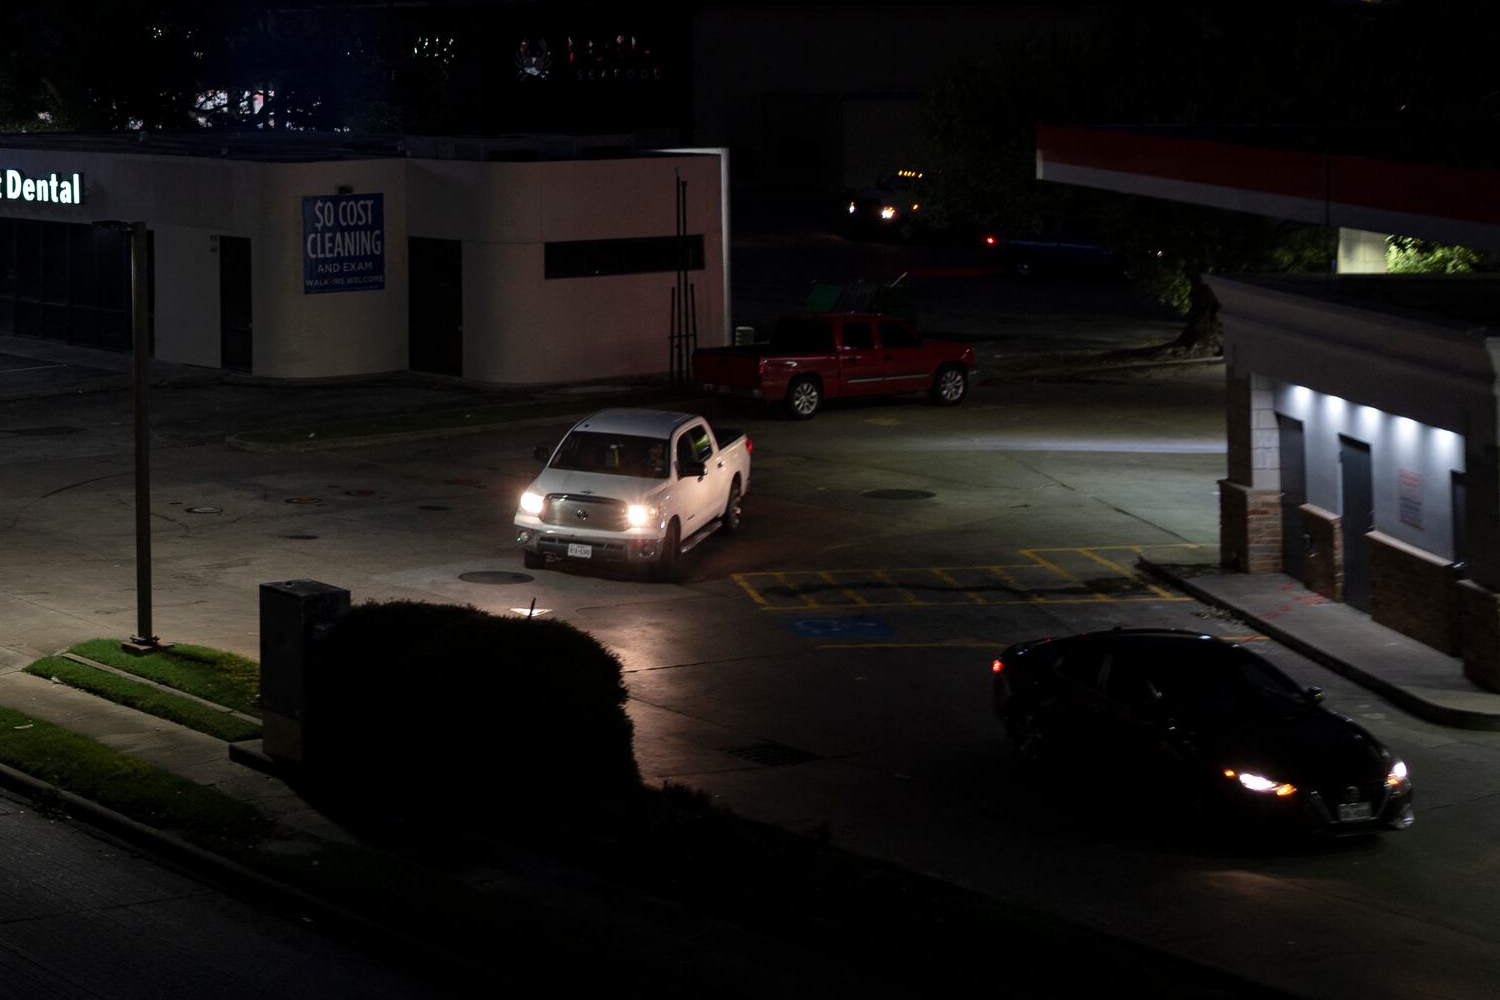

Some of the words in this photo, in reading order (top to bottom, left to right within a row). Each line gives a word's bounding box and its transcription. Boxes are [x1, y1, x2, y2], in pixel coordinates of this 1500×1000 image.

[7, 169, 80, 204] Dental
[314, 199, 335, 231] $0
[338, 199, 374, 227] COST
[307, 229, 382, 259] CLEANING
[316, 262, 340, 273] AND
[343, 260, 373, 272] EXAM
